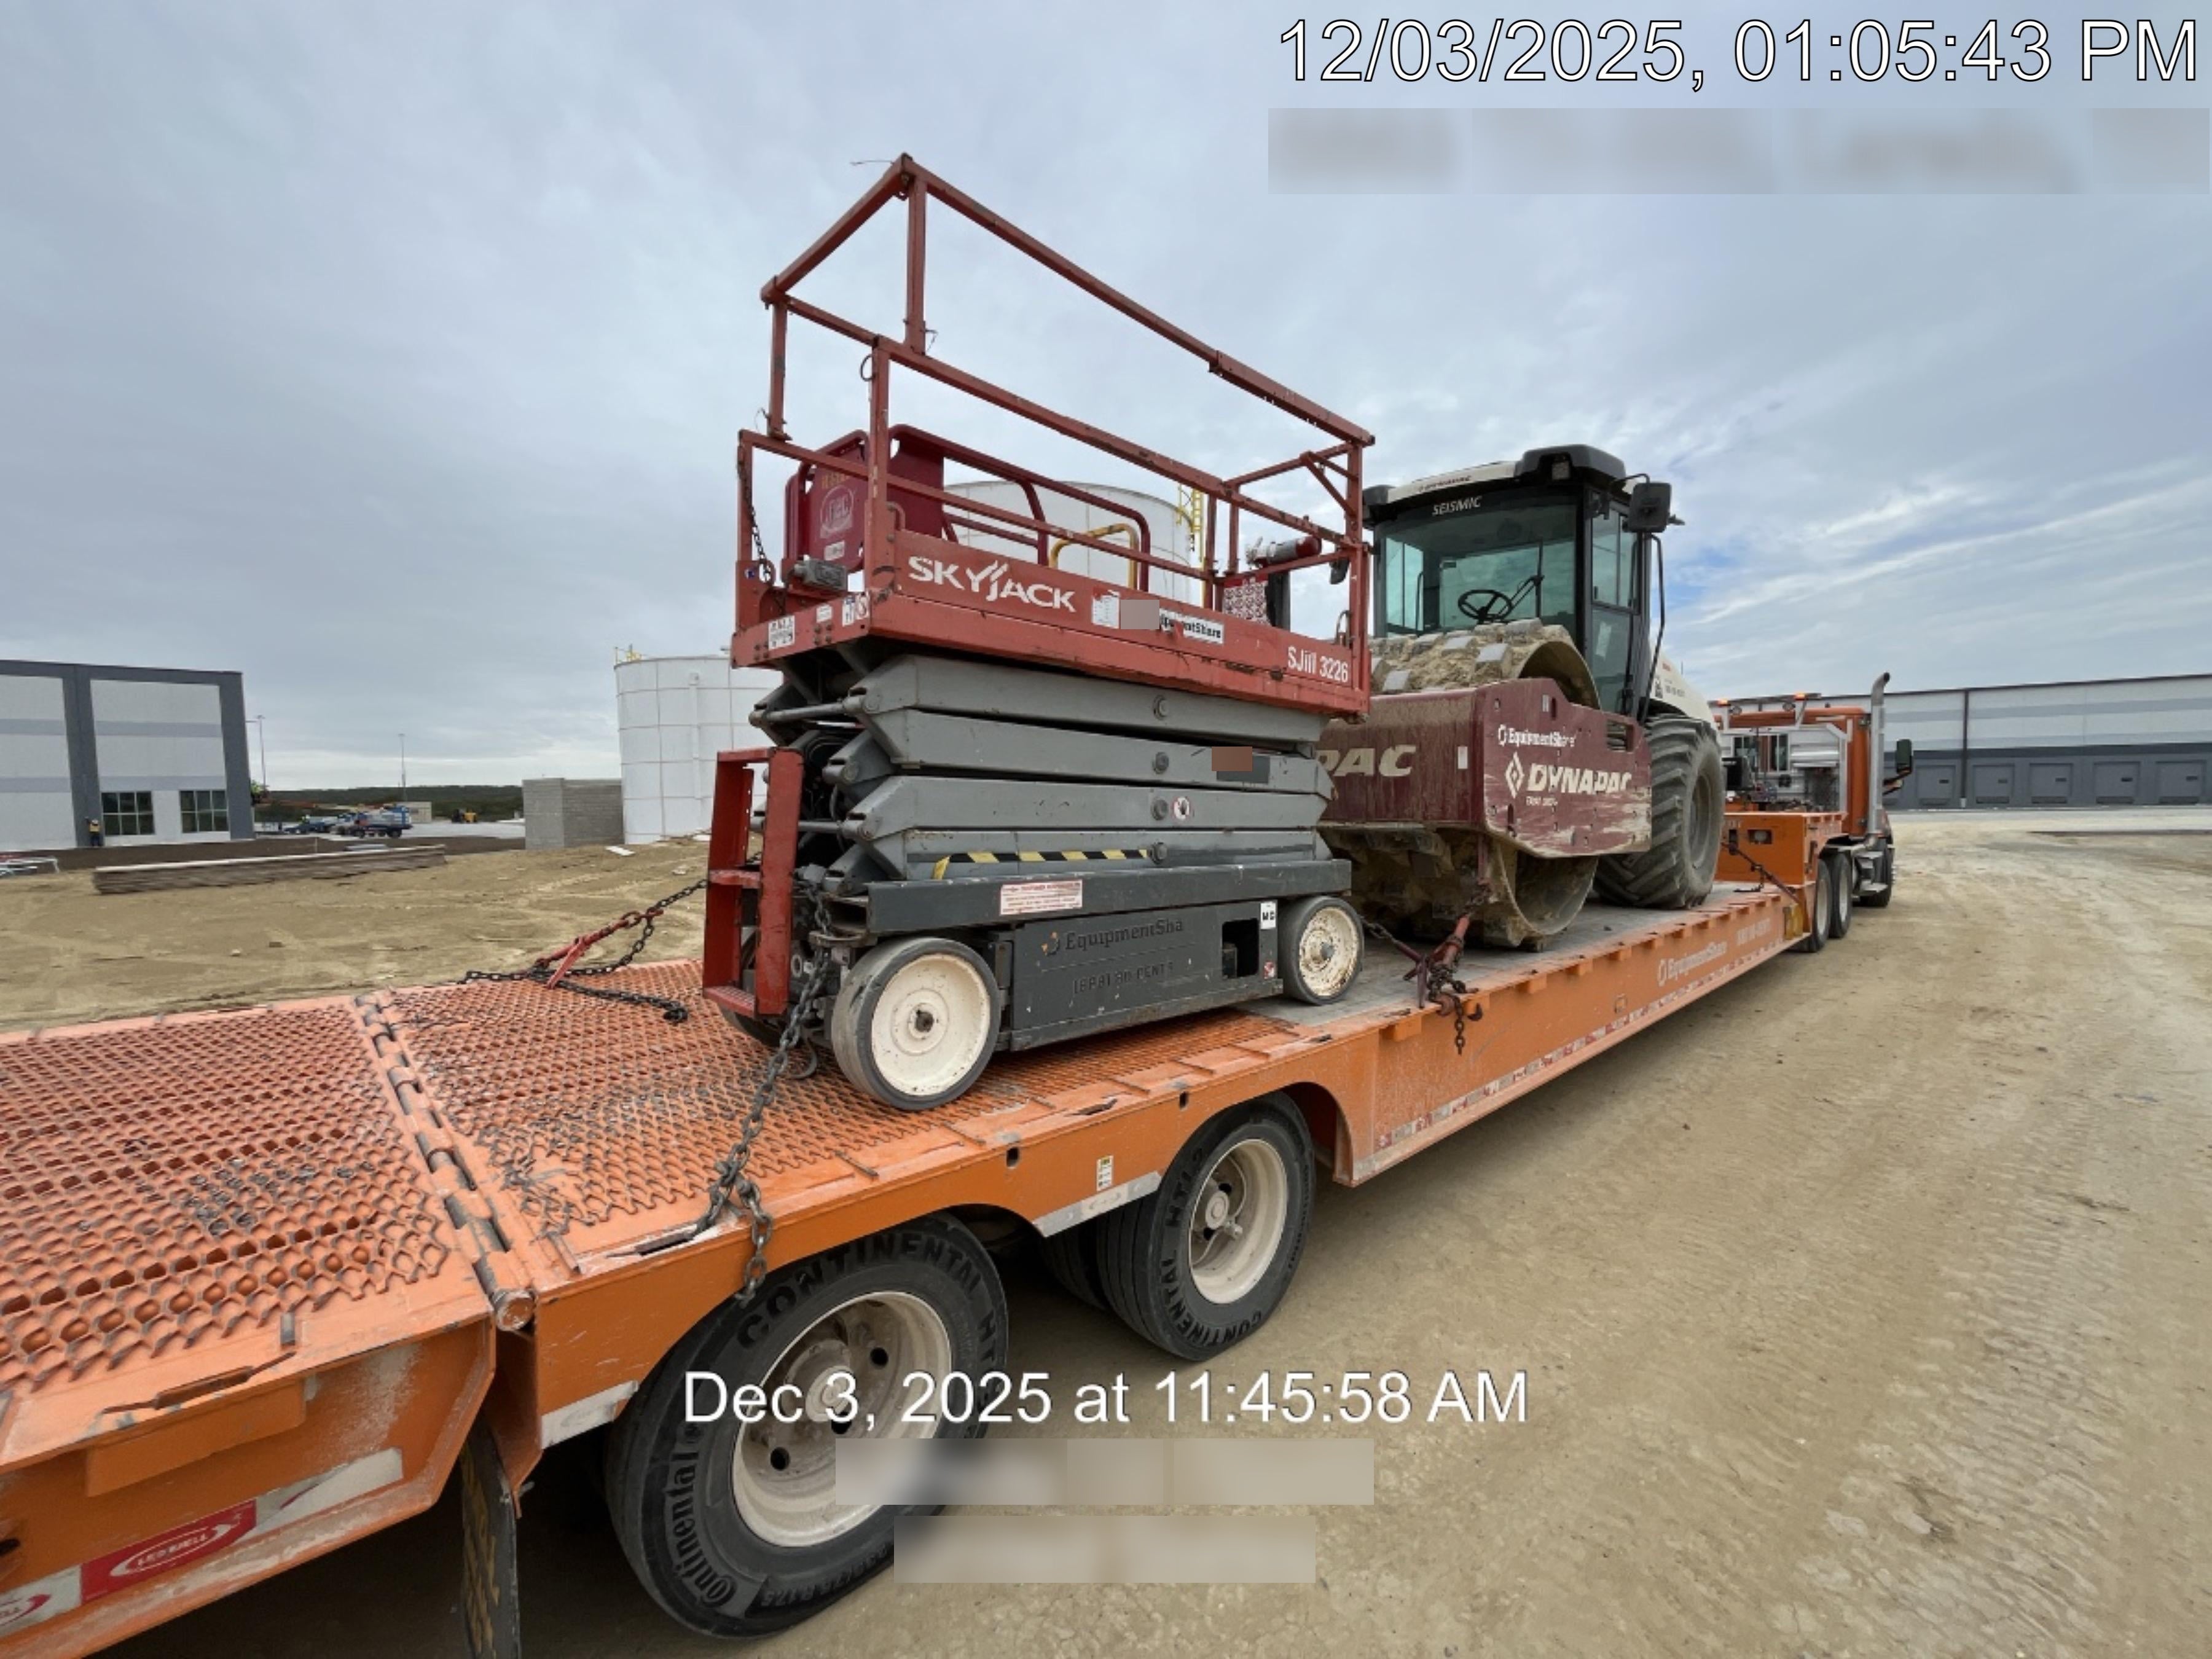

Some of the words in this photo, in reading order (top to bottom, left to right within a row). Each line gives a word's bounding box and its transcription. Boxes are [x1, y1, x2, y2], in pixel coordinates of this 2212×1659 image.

[1432, 495, 1482, 516] SEISMIC
[908, 555, 1076, 613] SKYJACK
[1319, 655, 1349, 683] 3226
[1526, 762, 1633, 795] DYNAPAC
[737, 1232, 981, 1349] CONTINENTAL
[664, 1450, 736, 1610] Continental
